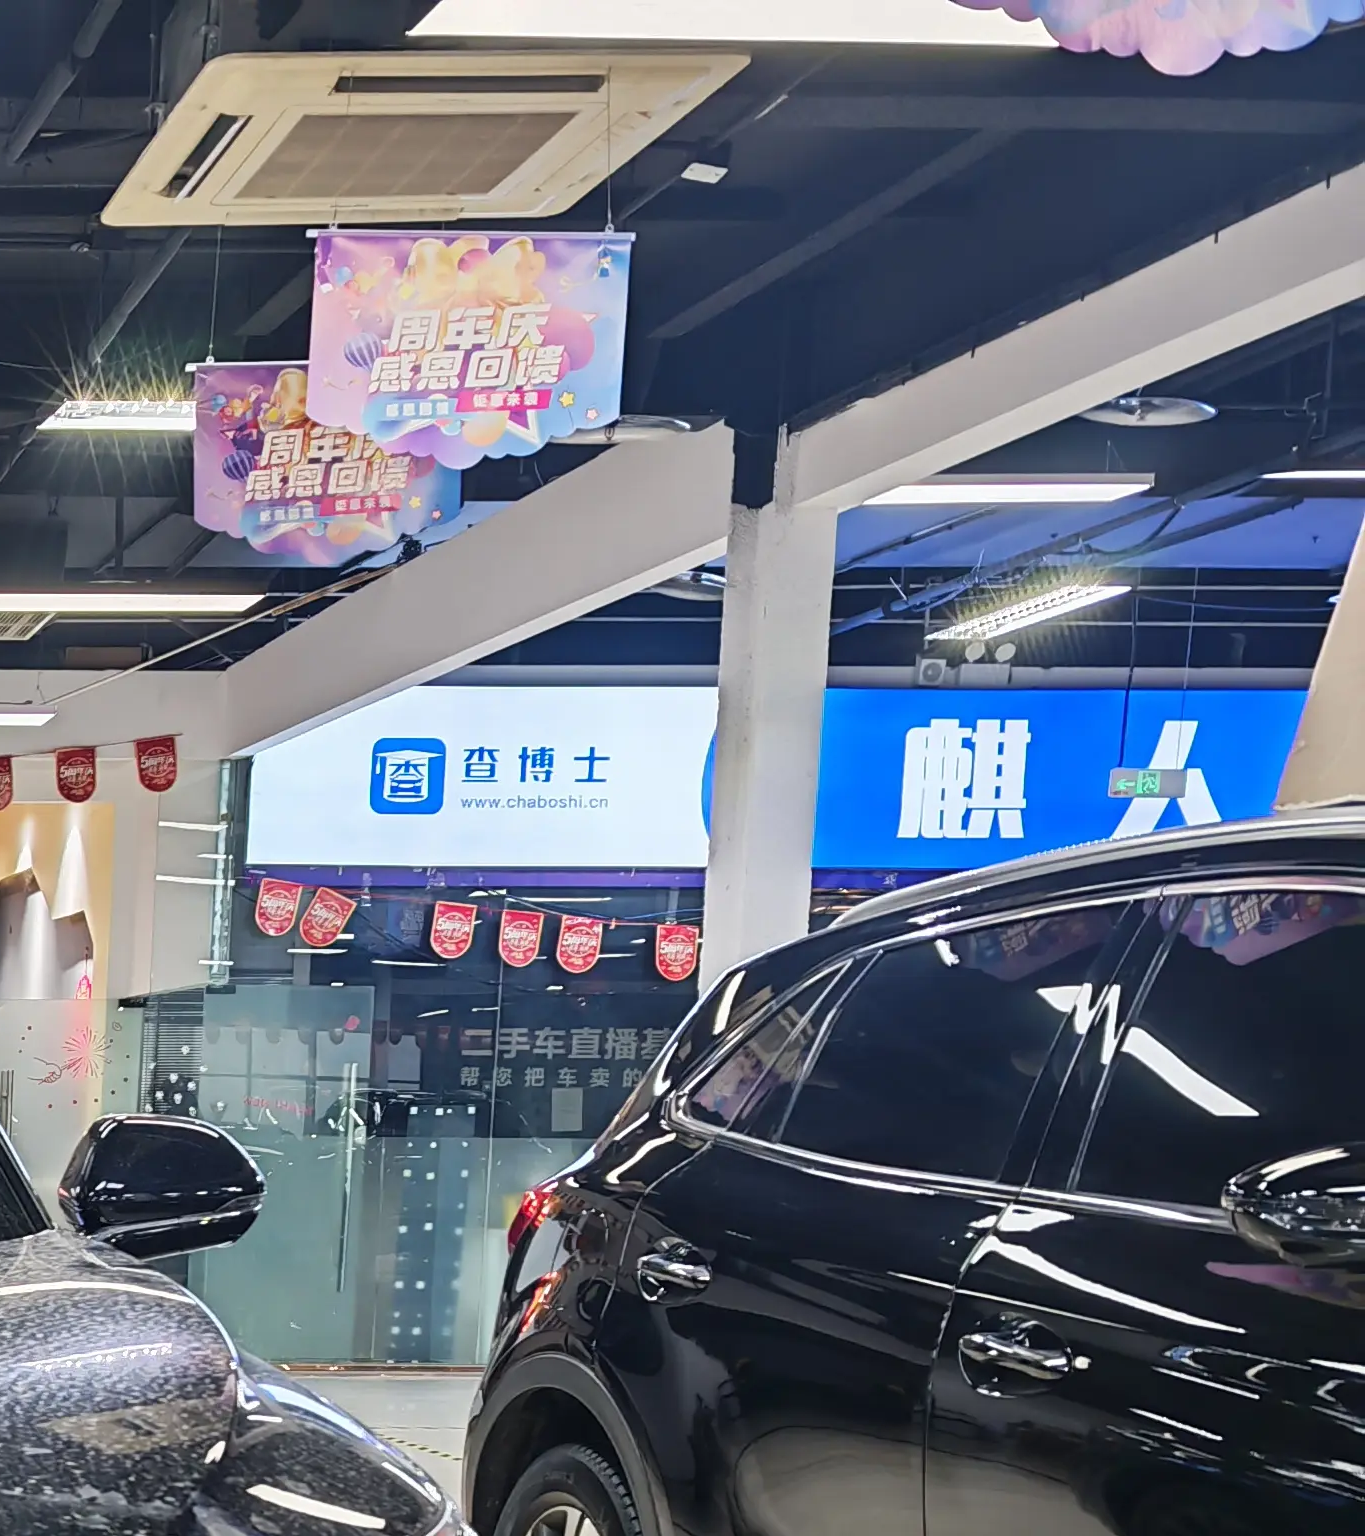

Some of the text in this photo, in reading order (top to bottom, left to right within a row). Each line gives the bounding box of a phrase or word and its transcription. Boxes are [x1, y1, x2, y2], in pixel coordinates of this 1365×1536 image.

[389, 302, 552, 353] 周年庆
[369, 345, 565, 395] 感恩回馈
[245, 455, 412, 502] 感恩回馈
[461, 747, 611, 783] 查博士
[460, 795, 609, 809] www.chaboshi.cn
